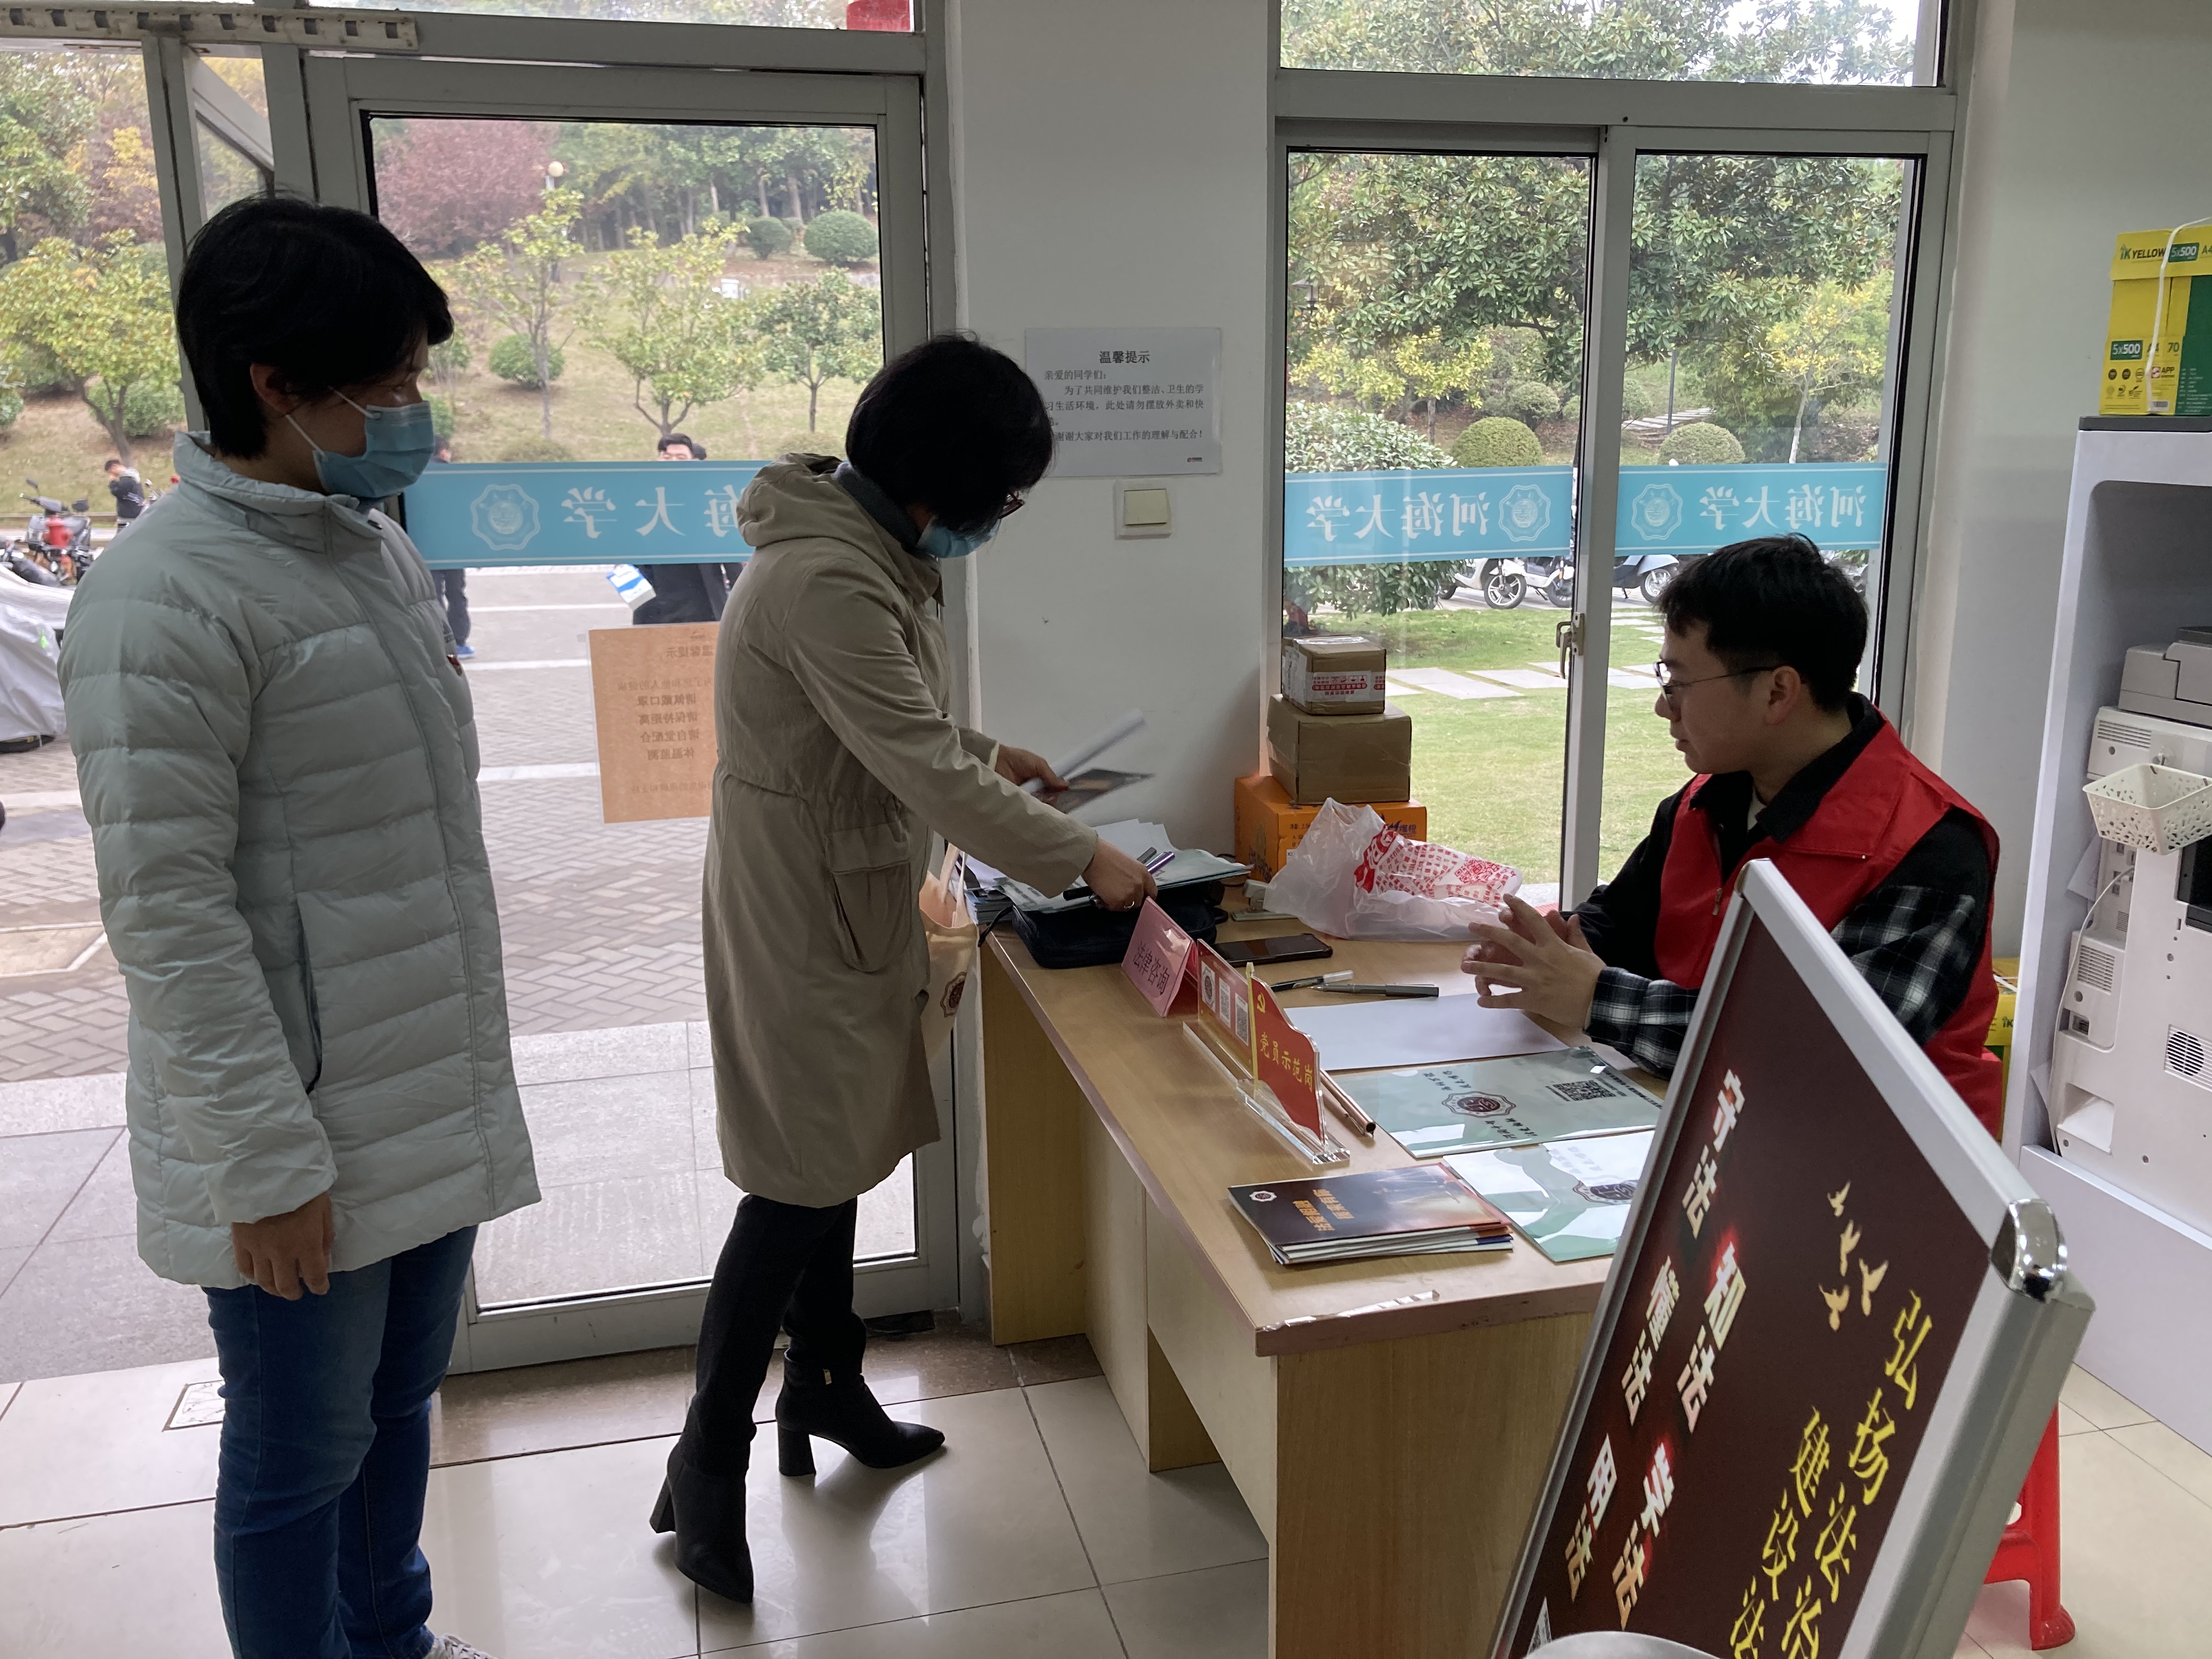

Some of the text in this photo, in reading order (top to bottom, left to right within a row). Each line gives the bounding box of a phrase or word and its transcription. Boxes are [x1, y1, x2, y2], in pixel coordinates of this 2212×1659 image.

[2132, 247, 2166, 259] YELLOW
[1099, 351, 1151, 364] 温馨提示
[2168, 342, 2180, 353] 70
[1132, 943, 1170, 996] 法律咨询
[1259, 1031, 1313, 1093] 党员示范岗
[1682, 1069, 1746, 1239] 守法
[1677, 1242, 1747, 1434] 知法
[1565, 1433, 1617, 1603] 用法
